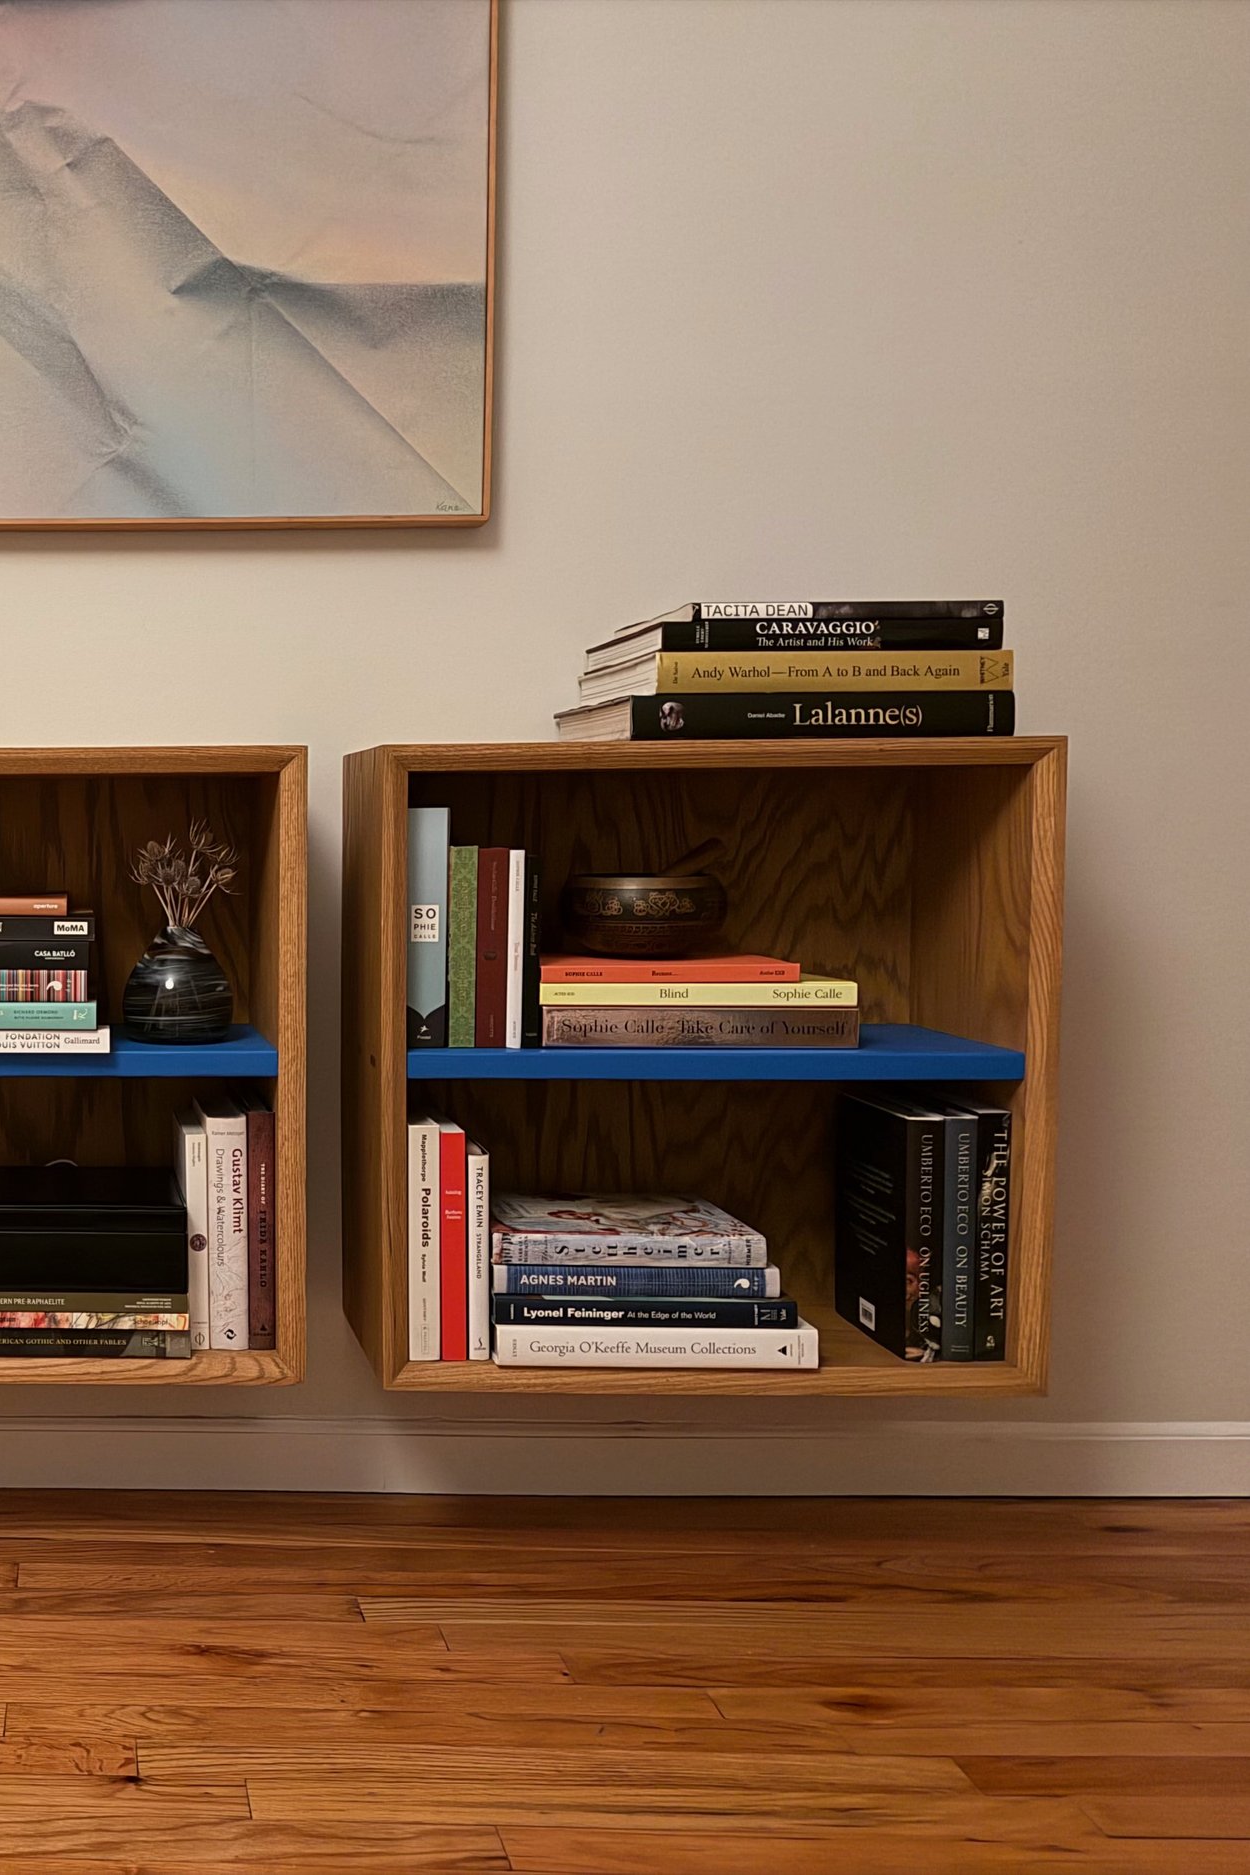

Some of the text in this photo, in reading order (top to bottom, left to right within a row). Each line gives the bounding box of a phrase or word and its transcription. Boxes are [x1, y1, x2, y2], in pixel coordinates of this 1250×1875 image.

[704, 604, 808, 617] TACITA DEAN
[755, 621, 875, 635] CARAVAGGIO
[756, 637, 873, 647] The Artist and His Work
[692, 666, 725, 680] Andy
[822, 666, 833, 677] A
[837, 667, 848, 677] to
[852, 666, 862, 677] B
[865, 665, 887, 677] and
[890, 665, 920, 677] Back
[924, 665, 960, 679] Again
[793, 701, 923, 727] Lalanne(s)
[413, 908, 436, 919] SO
[56, 924, 85, 932] MoMA
[413, 923, 436, 931] PHIE
[659, 988, 689, 998] Blind
[772, 989, 843, 1001] Sophie Calle
[561, 1018, 848, 1037] Sophie Calle Take Care of Yourself
[64, 1037, 100, 1045] Gallimard
[476, 1166, 484, 1200] TRACEY
[231, 1148, 244, 1234] Gustav Klimt
[213, 1148, 226, 1267] Drawings & Watercolours
[421, 1188, 432, 1248] Polaroids
[476, 1205, 484, 1228] EMIN
[989, 1129, 1008, 1319] THE POWER OF ART
[954, 1133, 970, 1328] UMBERTO ECO ON BEAUTY
[980, 1169, 992, 1281] SIMON SCHAMA
[918, 1134, 934, 1333] UMBERTO ECO ON UGLINESS
[259, 1210, 267, 1288] FRIDA KAHLO
[520, 1274, 617, 1286] AGNES MARTIN
[13, 1298, 65, 1306] PRE-RAPHAELITE
[523, 1307, 563, 1319] Lyonel
[567, 1308, 625, 1320] Feininger
[651, 1311, 670, 1319] Edge
[671, 1311, 680, 1319] of
[694, 1311, 716, 1319] World
[529, 1341, 757, 1357] Georgia O'Keeffe Museum Collections
